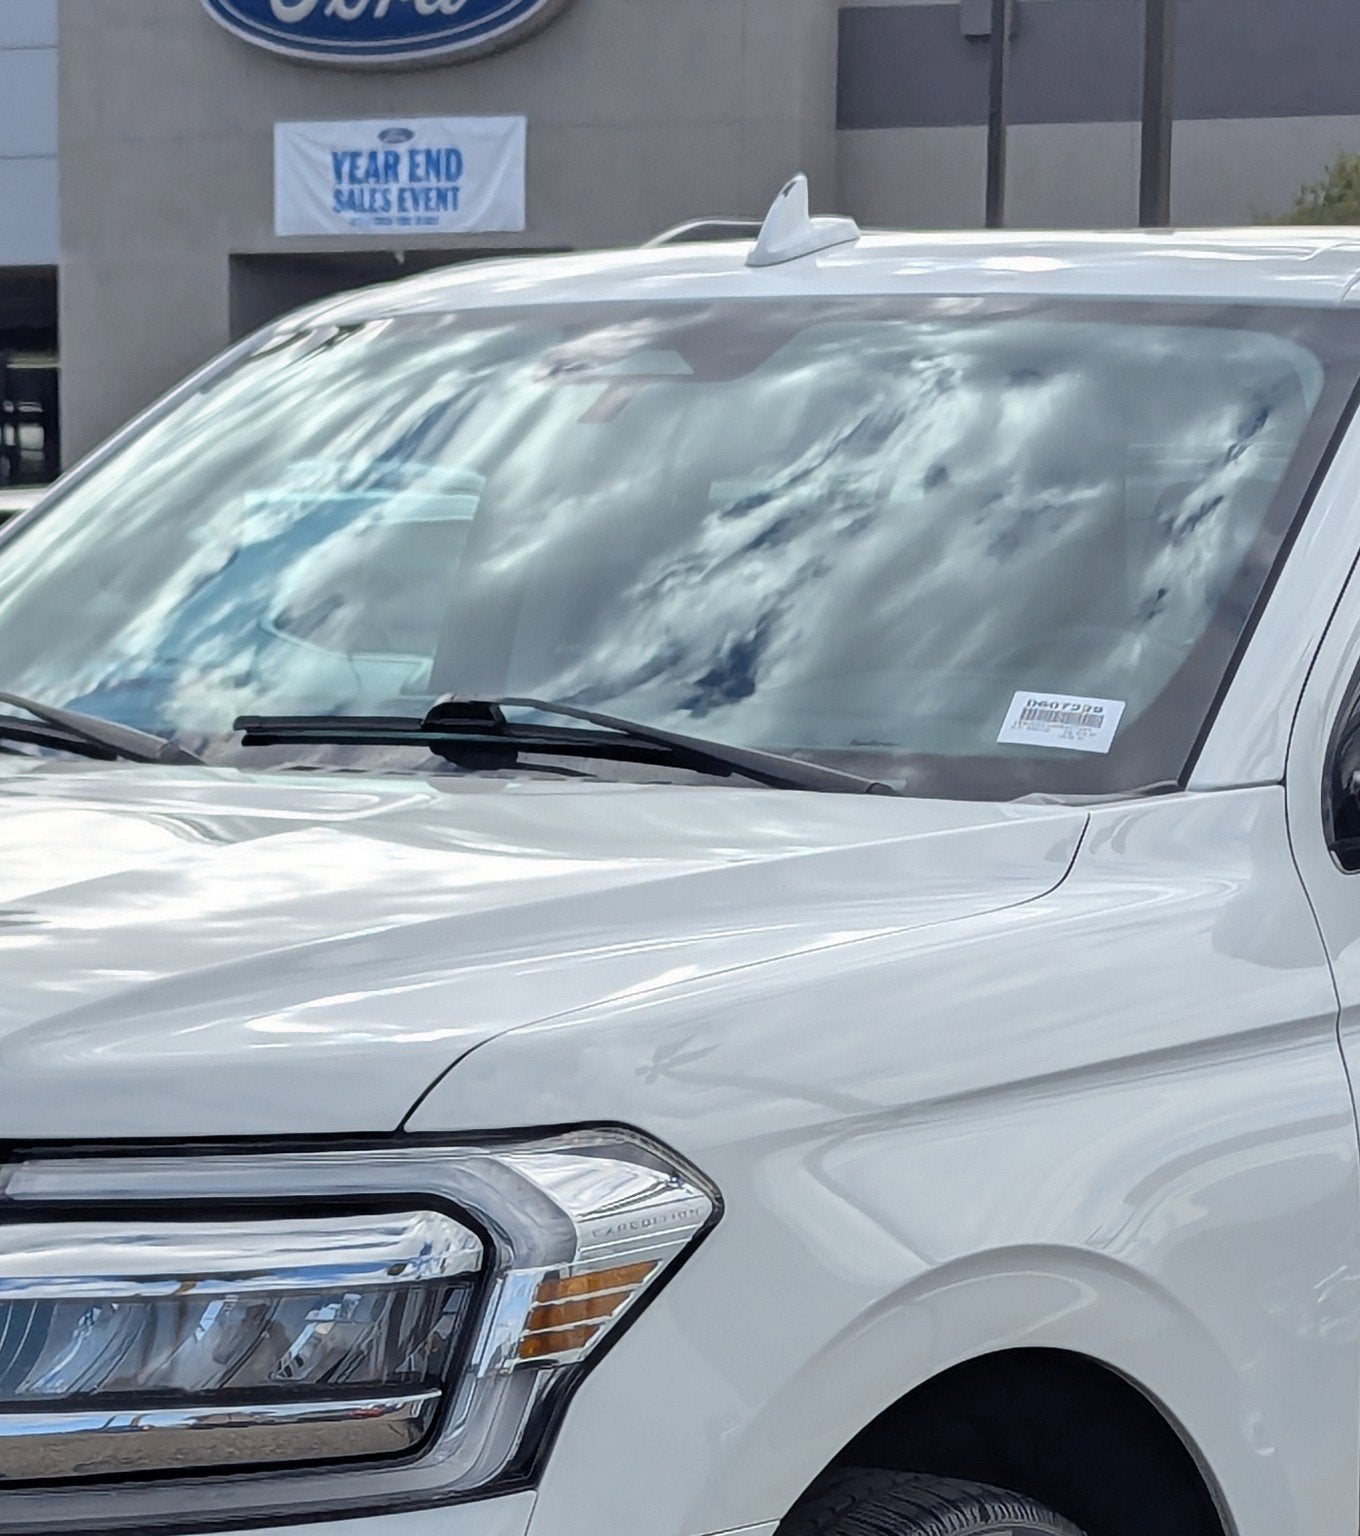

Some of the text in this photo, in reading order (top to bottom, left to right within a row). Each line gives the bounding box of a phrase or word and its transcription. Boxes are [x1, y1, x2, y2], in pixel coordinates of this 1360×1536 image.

[331, 147, 463, 185] YEAR END
[332, 185, 461, 214] SALES EVENT
